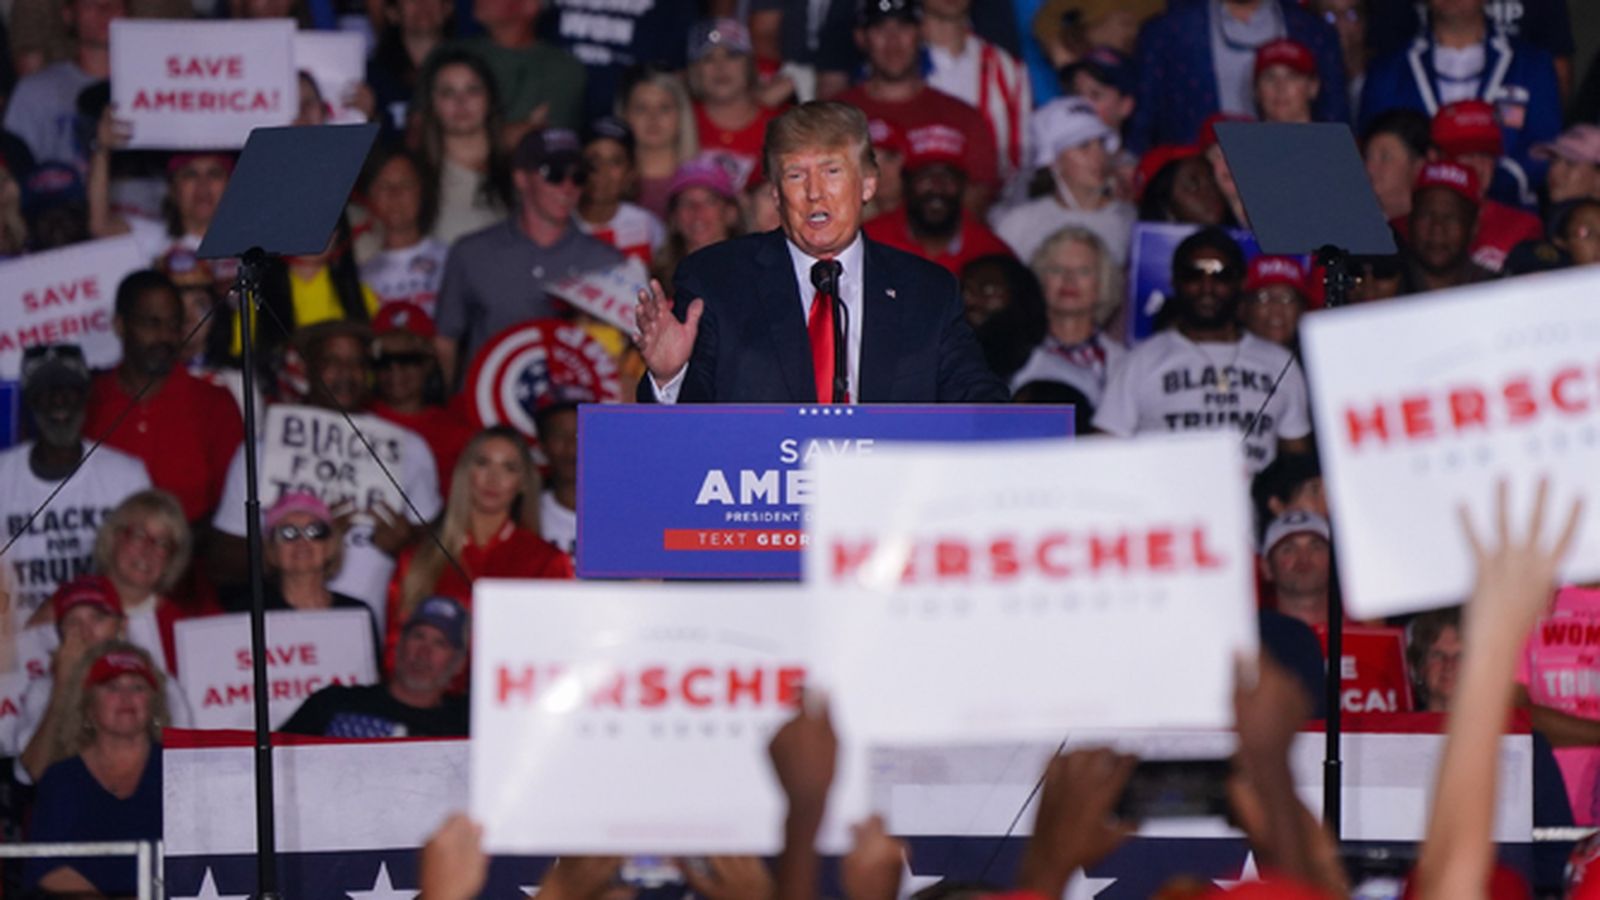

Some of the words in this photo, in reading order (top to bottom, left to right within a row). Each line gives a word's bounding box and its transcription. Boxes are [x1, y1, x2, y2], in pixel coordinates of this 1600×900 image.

[165, 54, 244, 79] SAVE
[132, 90, 281, 112] AMERICA!
[22, 275, 100, 314] SAVE
[1163, 365, 1276, 395] BLACKS
[1343, 362, 1600, 450] HERSC
[292, 455, 358, 486] FOR
[725, 510, 800, 523] PRESIDENT
[698, 532, 747, 546] TEXT
[829, 525, 1226, 584] HRSCHEL
[494, 660, 808, 710] HRSCHE
